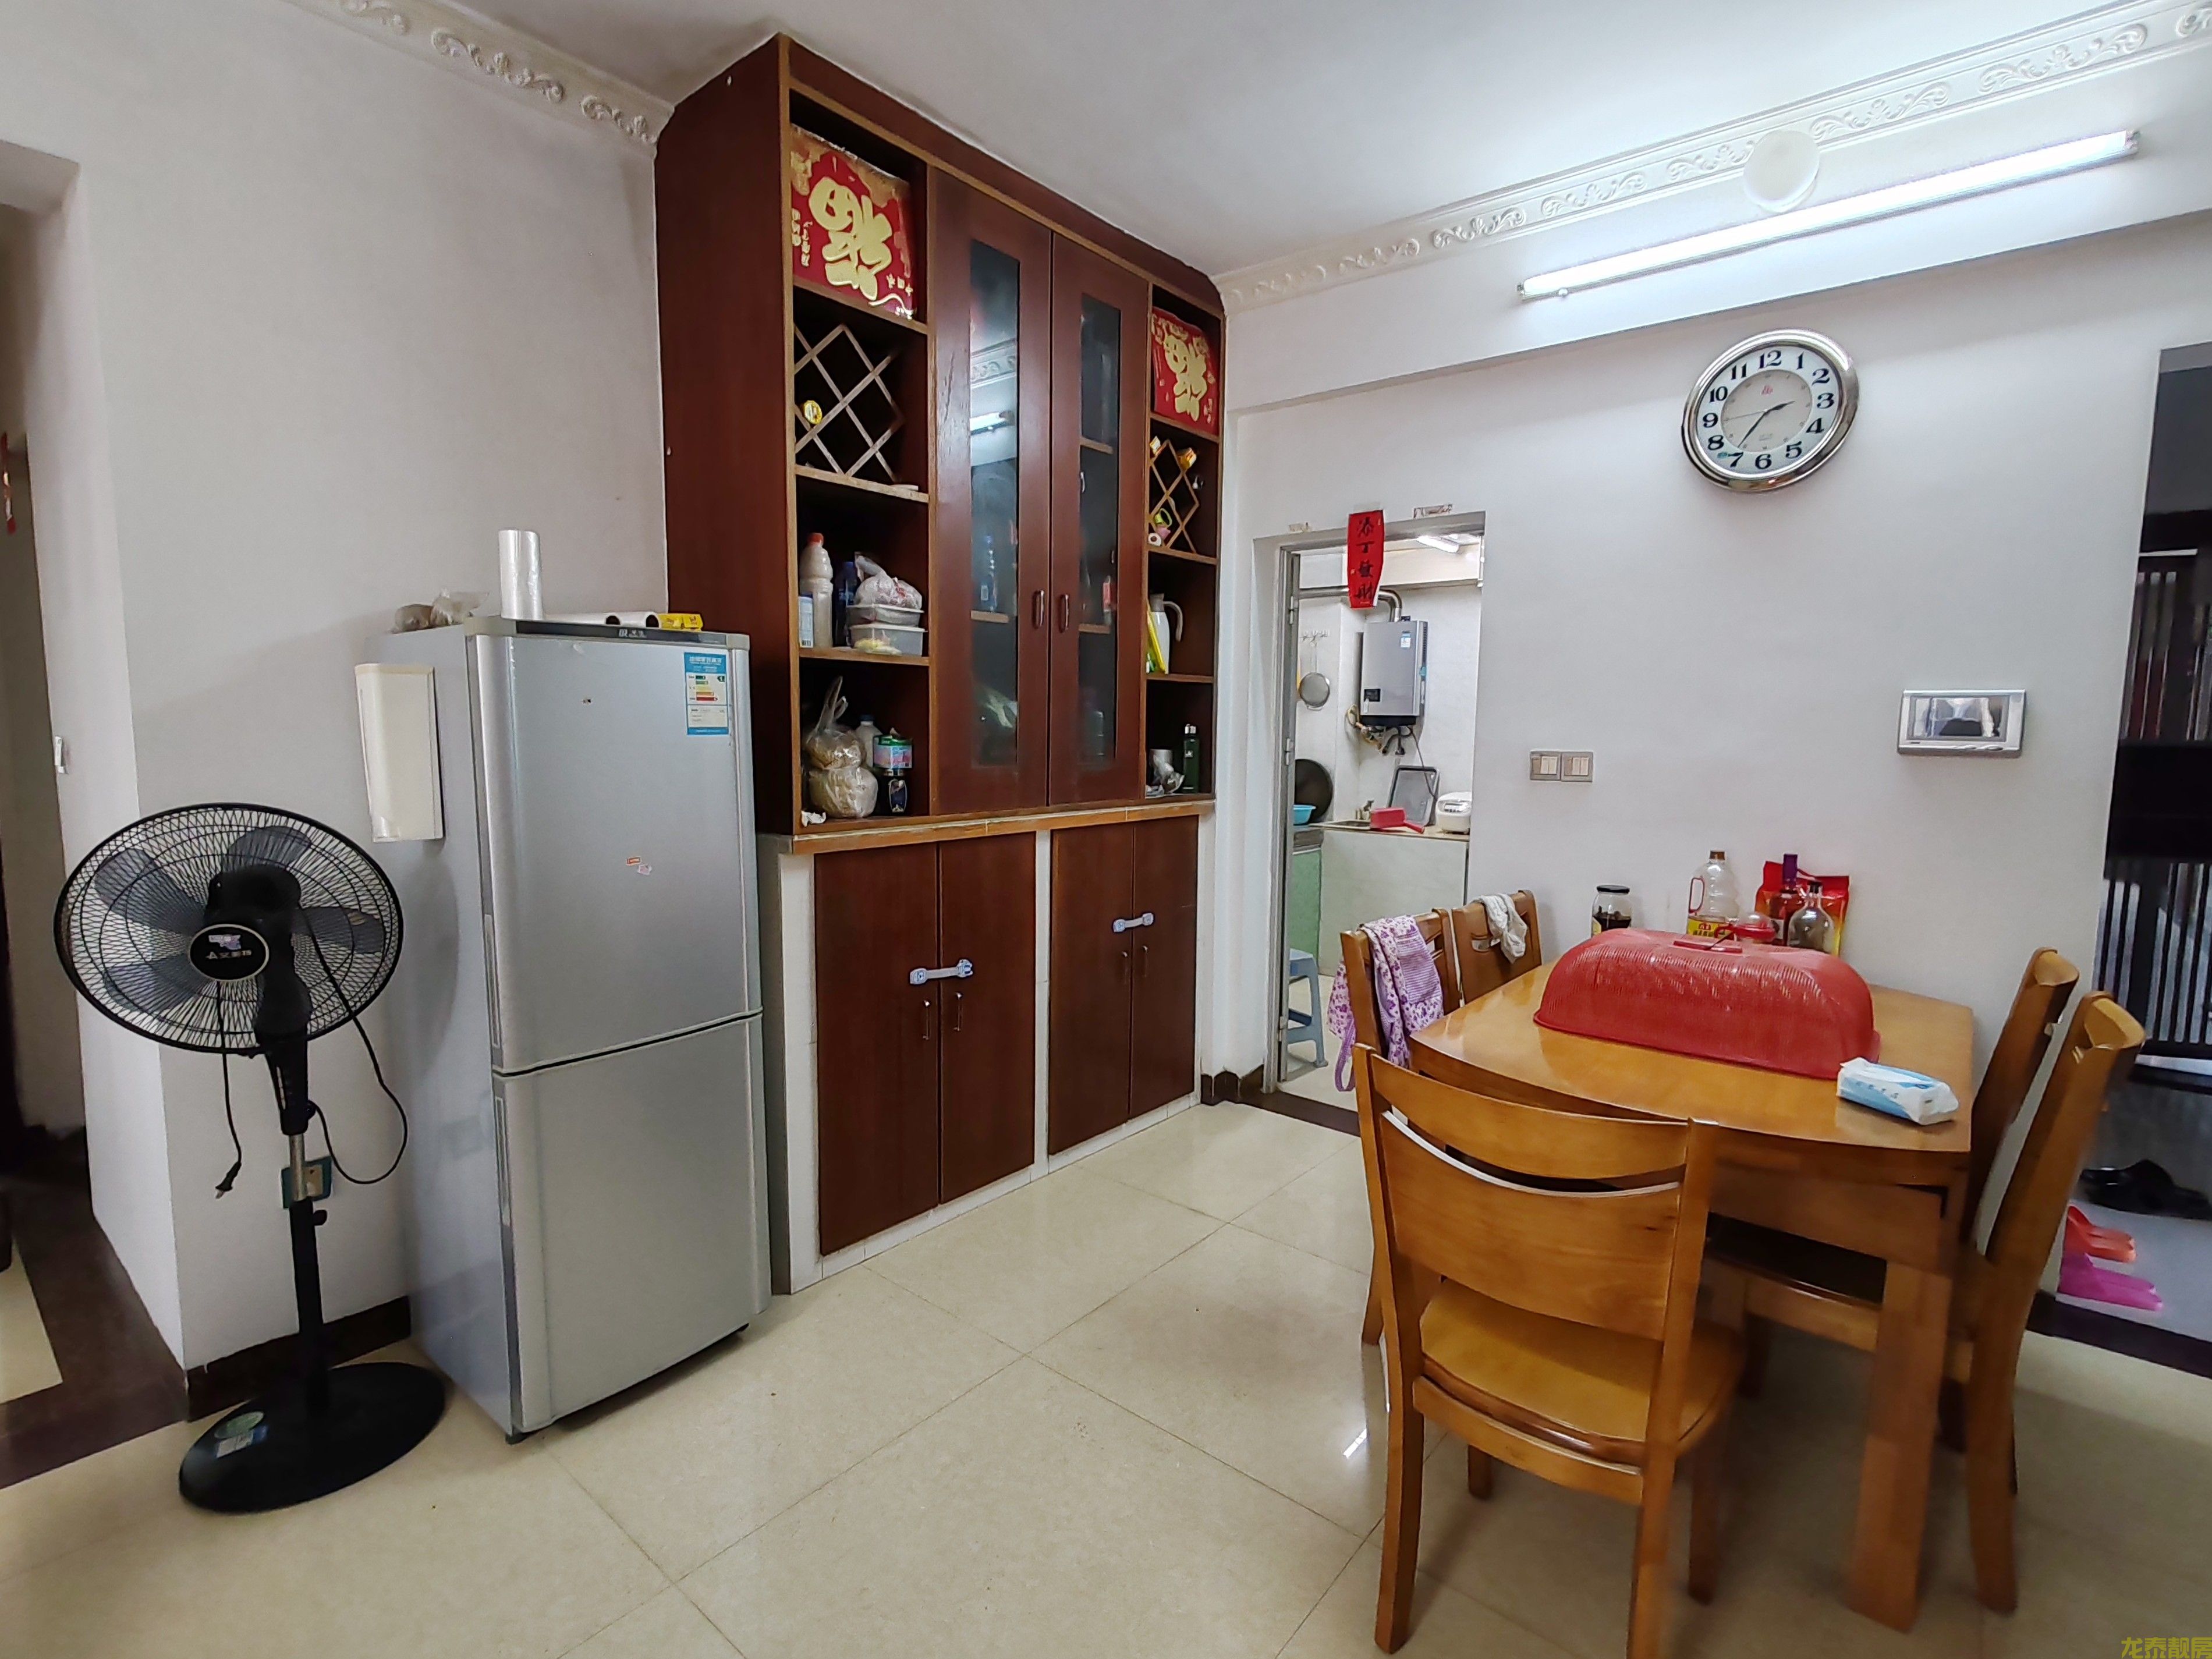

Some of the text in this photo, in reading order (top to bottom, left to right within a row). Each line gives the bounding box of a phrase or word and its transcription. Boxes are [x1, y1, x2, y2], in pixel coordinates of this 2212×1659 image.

[1758, 350, 1782, 369] 12
[1796, 352, 1804, 369] 1
[1731, 363, 1747, 380] 11
[1812, 368, 1830, 385] 2
[1709, 386, 1728, 402] 10
[1817, 393, 1834, 409] 3
[1703, 413, 1718, 427] 9
[1806, 418, 1824, 434] 4
[1708, 435, 1724, 450] 8
[1785, 441, 1802, 459] 5
[1728, 452, 1743, 467] 7
[1755, 453, 1772, 469] 6
